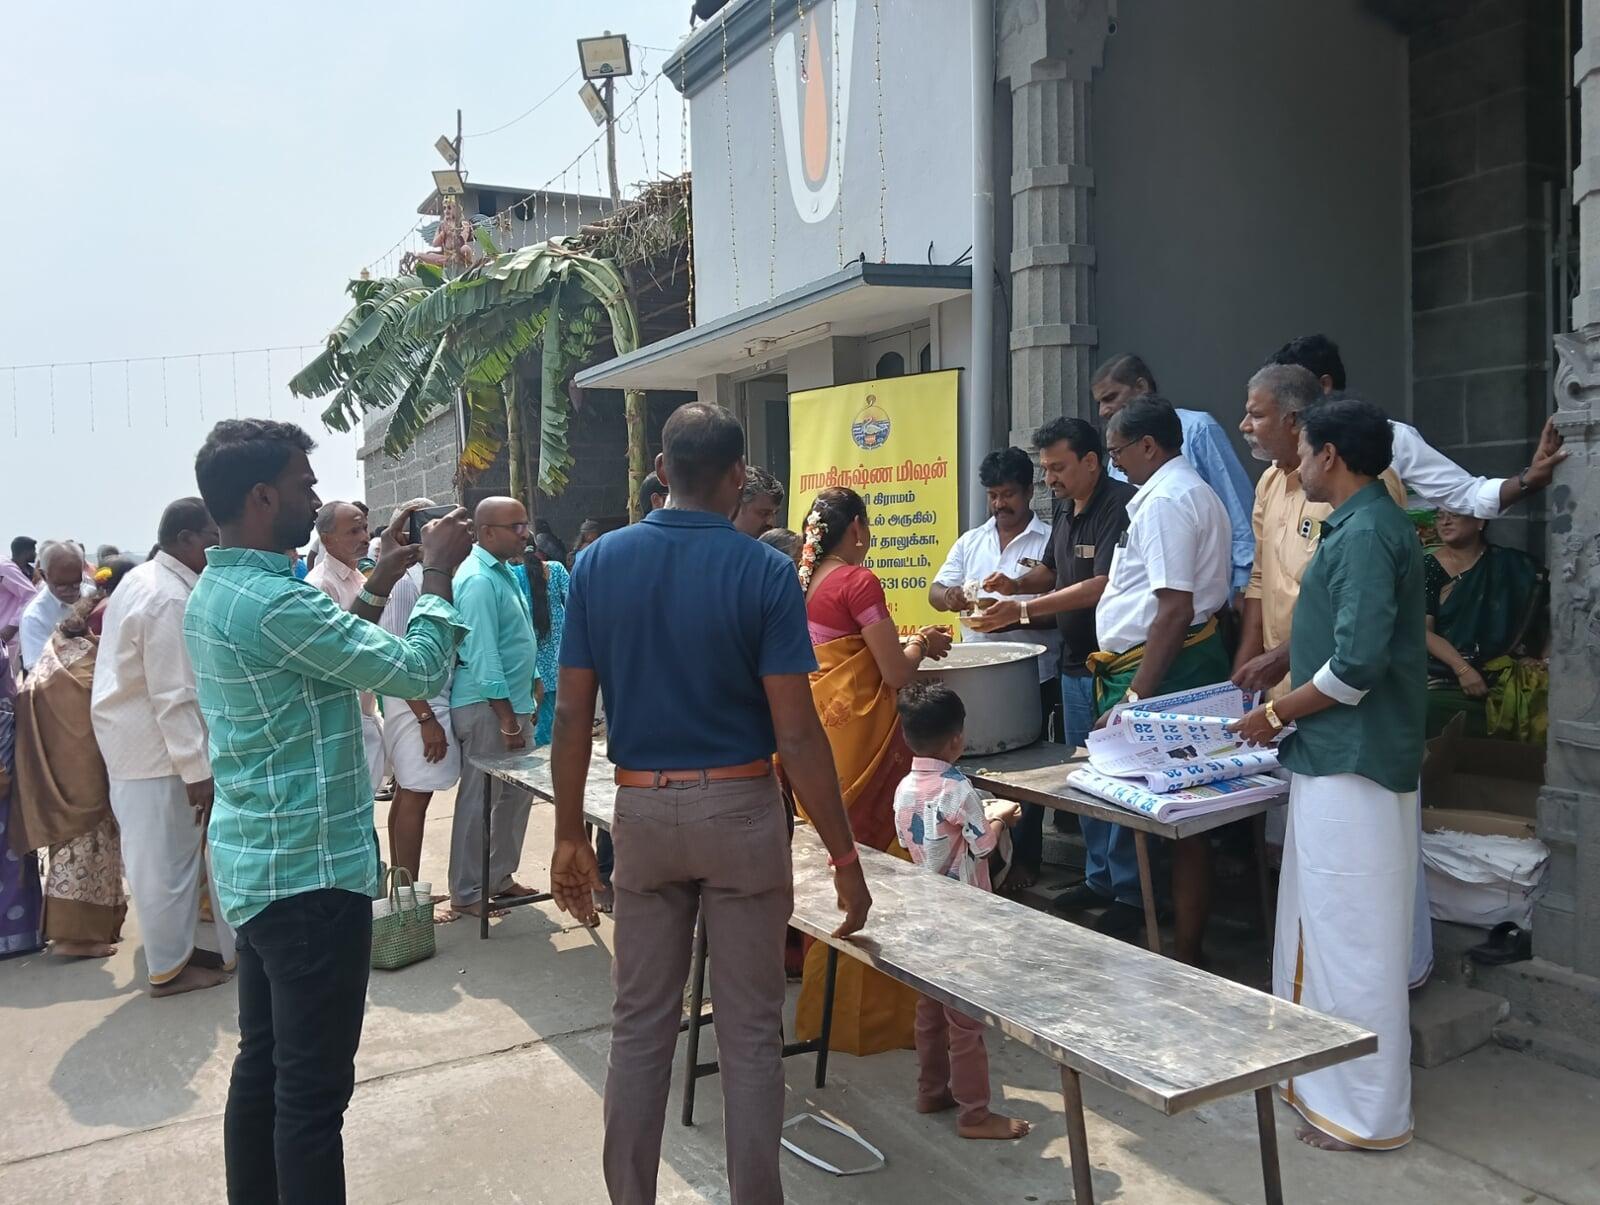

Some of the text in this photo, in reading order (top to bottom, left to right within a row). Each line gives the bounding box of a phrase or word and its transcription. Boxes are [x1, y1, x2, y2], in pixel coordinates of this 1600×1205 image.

[799, 456, 948, 494] ராமகிருஷ்ண மிஷன்
[873, 490, 915, 506] கிராமம்
[888, 510, 937, 527] அருகில்)
[880, 533, 939, 550] தாலுக்கா,
[880, 577, 927, 589] 631 606
[1134, 723, 1153, 733] 28
[1160, 724, 1178, 733] 21
[1188, 725, 1207, 733] 14
[1164, 734, 1183, 742] 20
[1223, 732, 1234, 740] 6
[1206, 761, 1225, 771] 15
[1231, 758, 1243, 767] 8
[1162, 768, 1183, 779] 29
[1184, 765, 1204, 775] 22
[1126, 792, 1142, 805] 21
